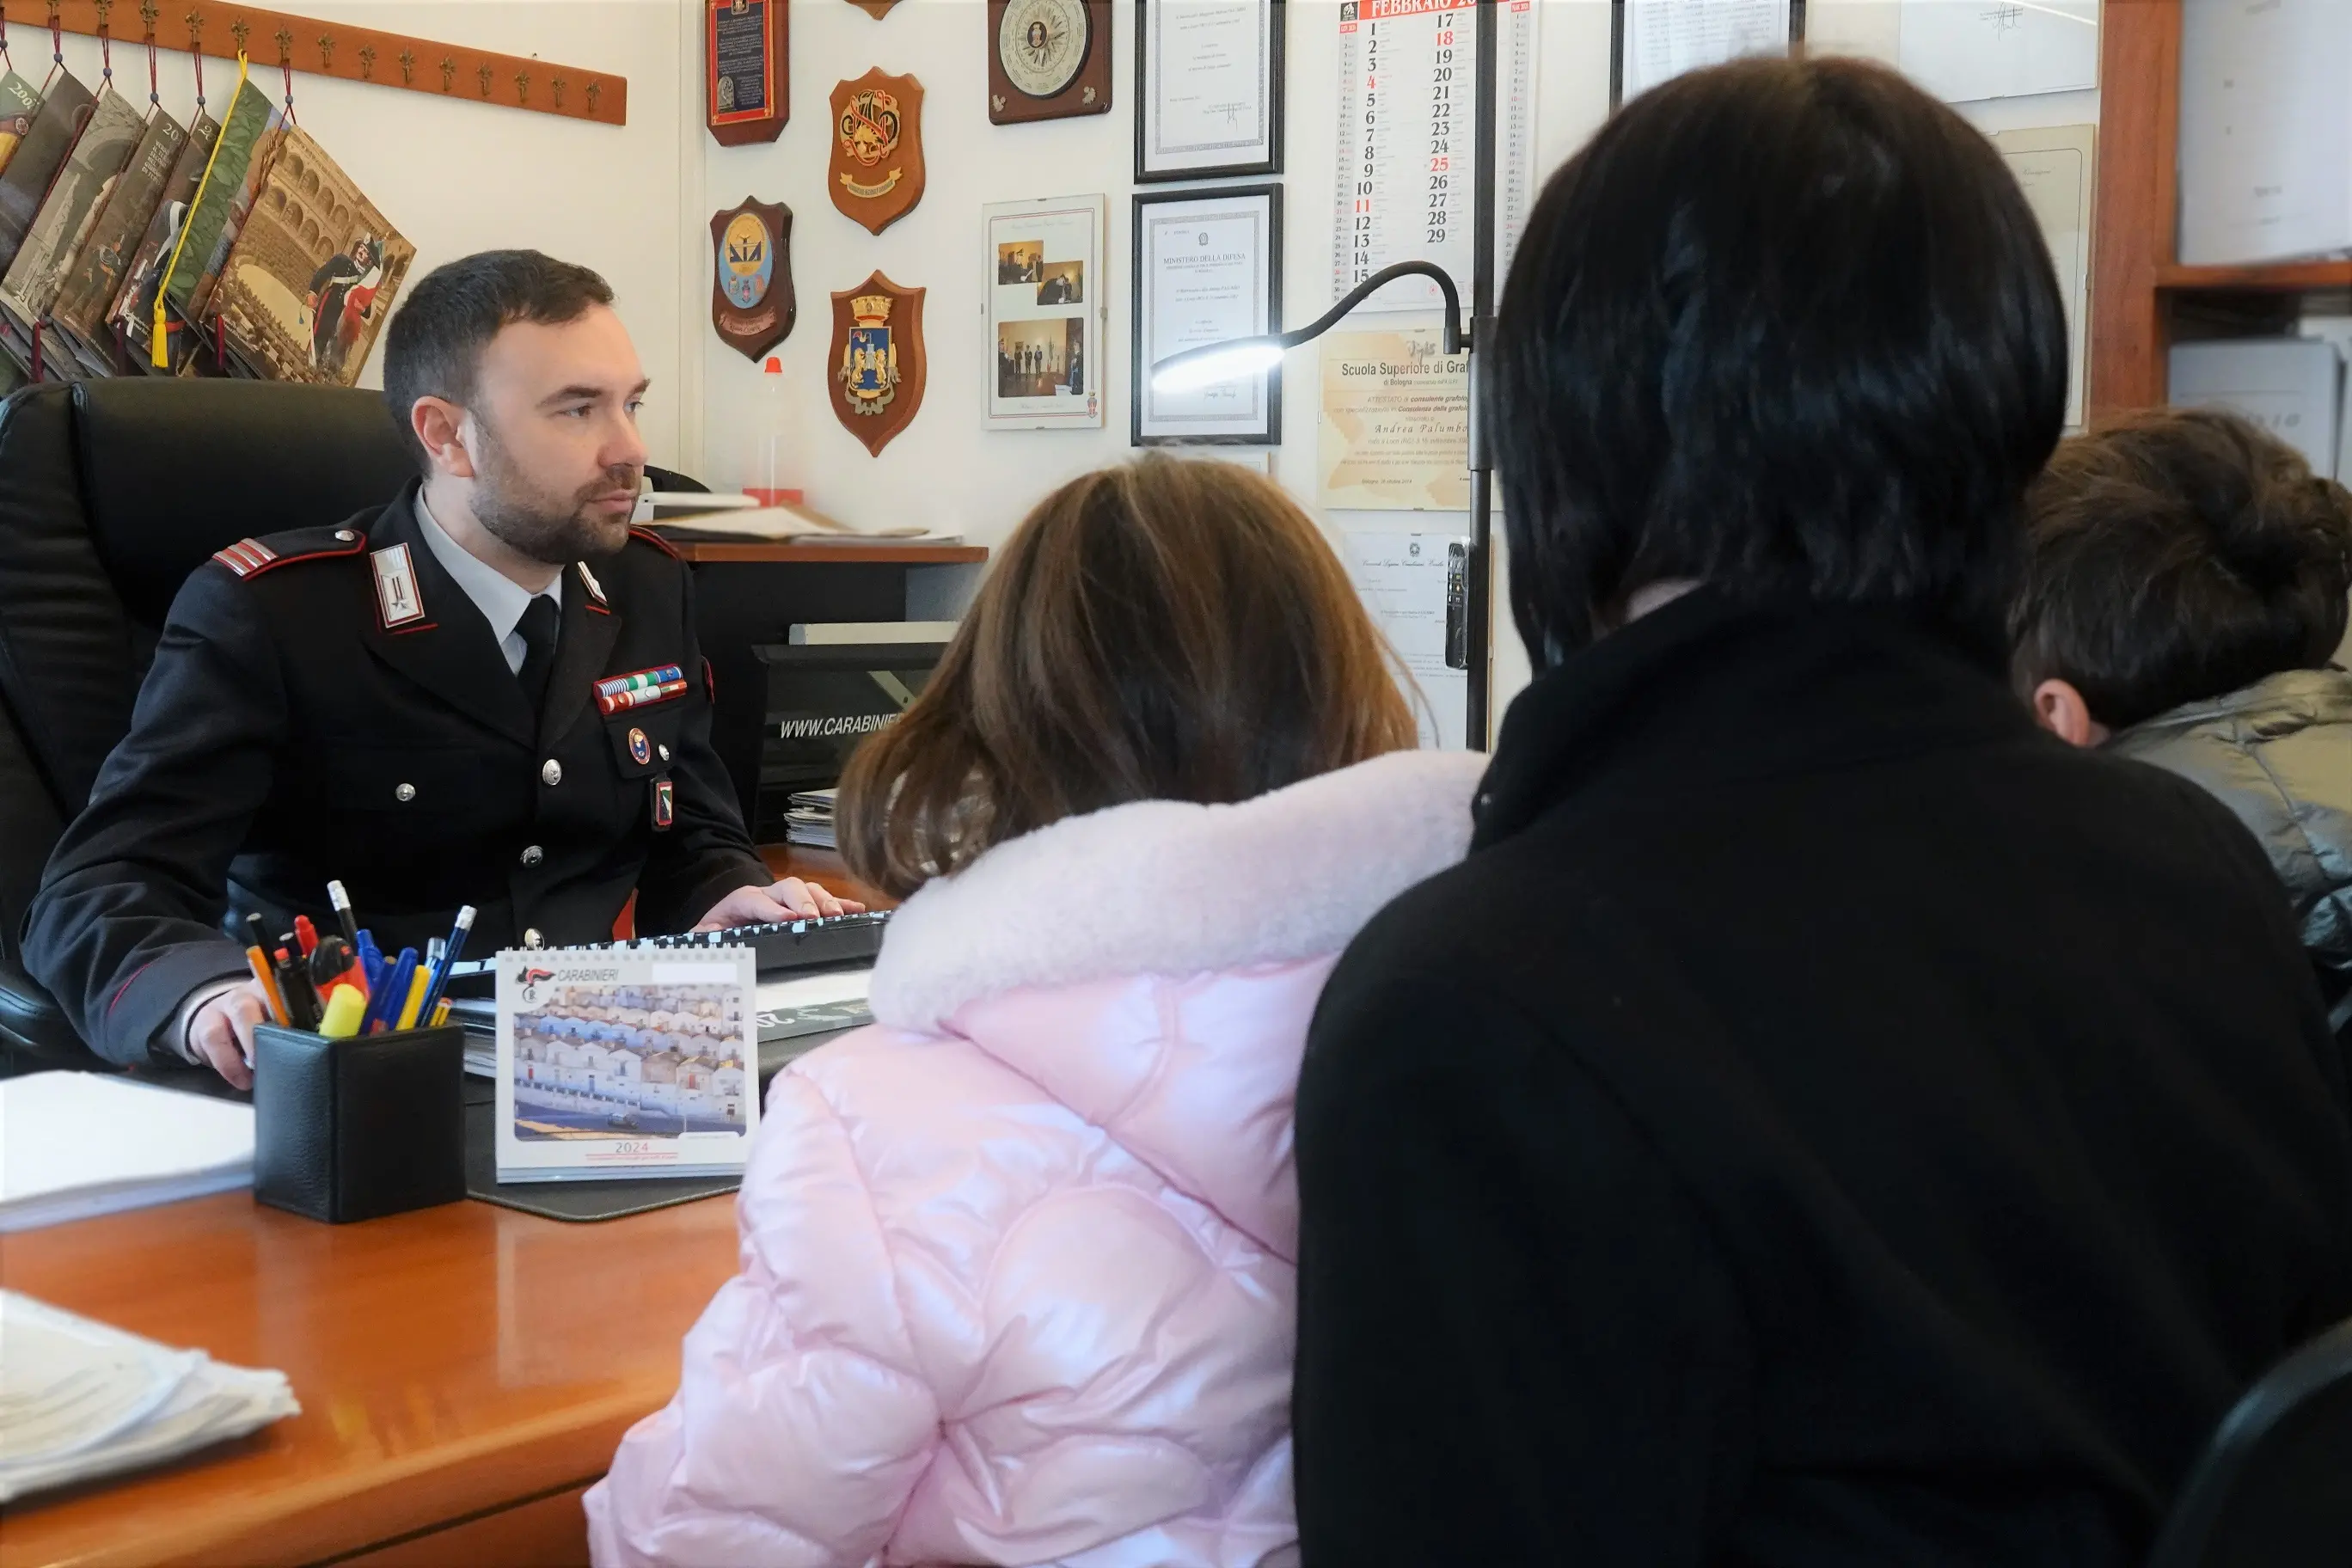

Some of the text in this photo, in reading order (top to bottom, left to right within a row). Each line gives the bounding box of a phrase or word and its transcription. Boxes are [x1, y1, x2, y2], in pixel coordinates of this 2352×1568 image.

[1438, 14, 1453, 28] 17
[1371, 22, 1375, 36] 1
[1437, 31, 1453, 46] 18
[1369, 40, 1377, 54] 2
[1436, 49, 1453, 64] 19
[1368, 58, 1377, 71] 3
[1367, 76, 1375, 89] 4
[1434, 68, 1452, 83] 20
[1367, 94, 1375, 107] 5
[1433, 86, 1449, 101] 21
[1433, 103, 1449, 117] 22
[1365, 111, 1375, 125] 6
[1432, 122, 1449, 135] 23
[1366, 129, 1375, 143] 7
[1364, 146, 1375, 160] 8
[1430, 139, 1449, 154] 24
[1364, 163, 1374, 177] 9
[1430, 157, 1449, 172] 25
[1357, 181, 1373, 195] 10
[1430, 175, 1448, 190] 26
[1355, 199, 1370, 213] 11
[1430, 193, 1447, 208] 27
[1355, 217, 1371, 230] 12
[1429, 211, 1446, 224] 28
[1354, 235, 1370, 248] 13
[1427, 229, 1446, 243] 29
[1163, 255, 1199, 265] MINISTERO
[1222, 253, 1246, 261] DIFESA
[1354, 250, 1369, 266] 14
[1354, 270, 1369, 284] 15
[1341, 363, 1376, 376] Scuola
[1379, 361, 1430, 377] Superiore
[1434, 361, 1443, 374] di
[1390, 377, 1412, 387] Bologna
[1410, 395, 1444, 403] consulente
[1375, 421, 1468, 433] Andrea Palumbo
[558, 969, 619, 982] CARABINIERI
[616, 1142, 649, 1154] 2024
